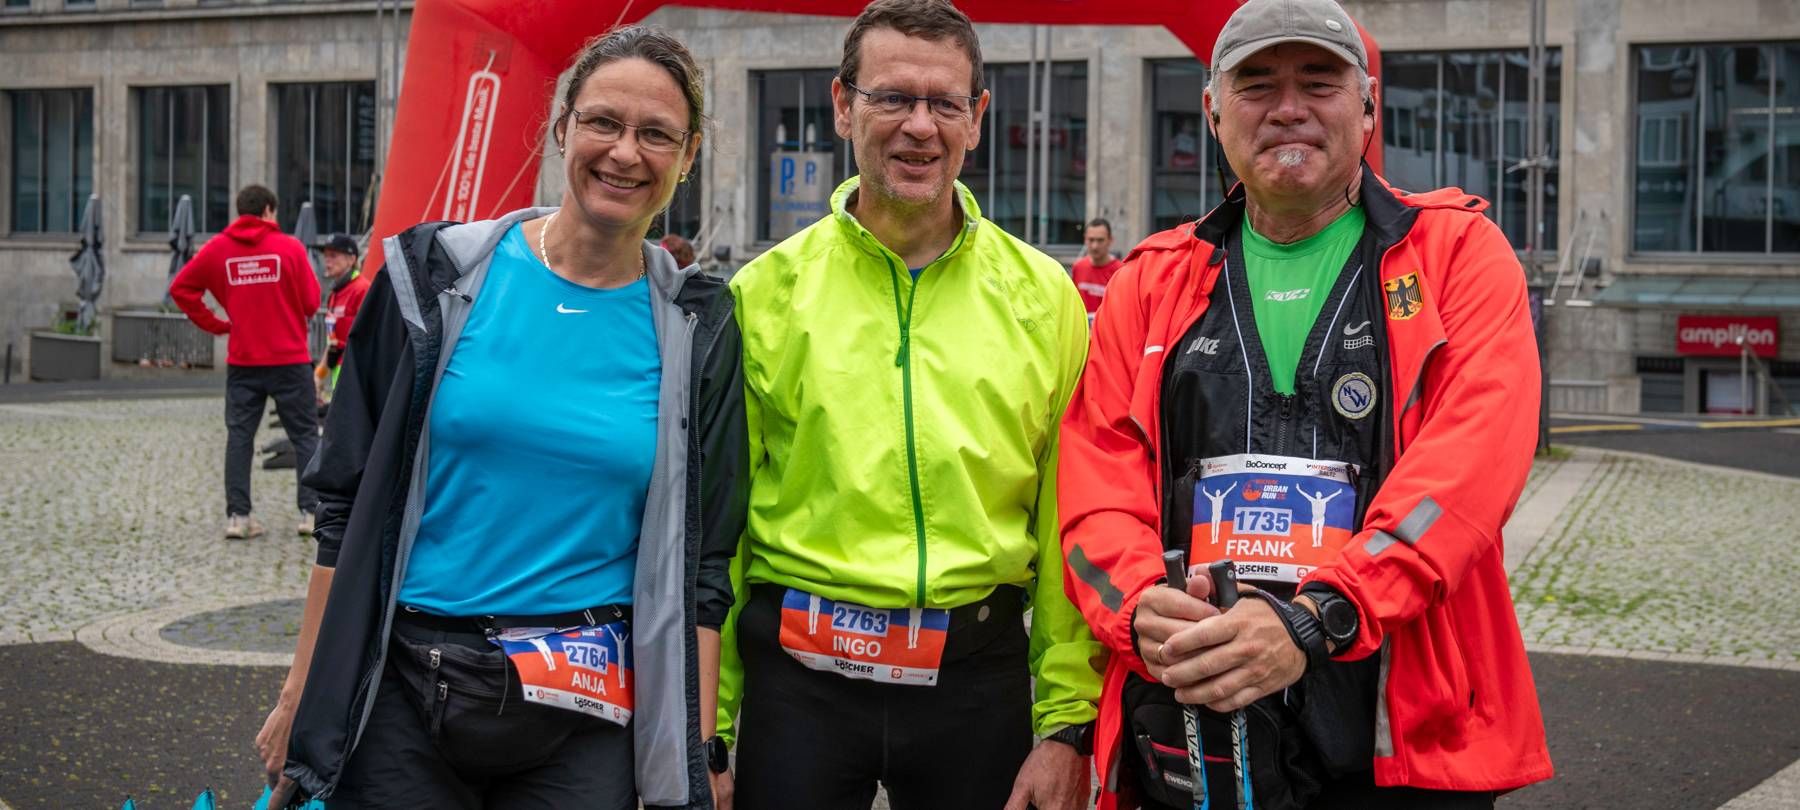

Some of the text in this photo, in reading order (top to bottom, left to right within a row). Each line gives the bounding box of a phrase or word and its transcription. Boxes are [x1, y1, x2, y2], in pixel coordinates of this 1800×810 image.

[1680, 323, 1775, 349] amplifon
[1245, 460, 1287, 471] BoConcept
[1261, 491, 1278, 500] RUN
[1263, 484, 1289, 493] URBAN
[1236, 511, 1290, 533] 1735
[1225, 540, 1295, 558] FRANK
[833, 607, 889, 633] 2763
[833, 635, 881, 657] INGO
[565, 645, 607, 670] 2764
[571, 671, 607, 696] ANJA
[574, 696, 604, 711] LÖSCHER
[1169, 775, 1193, 788] WENG
